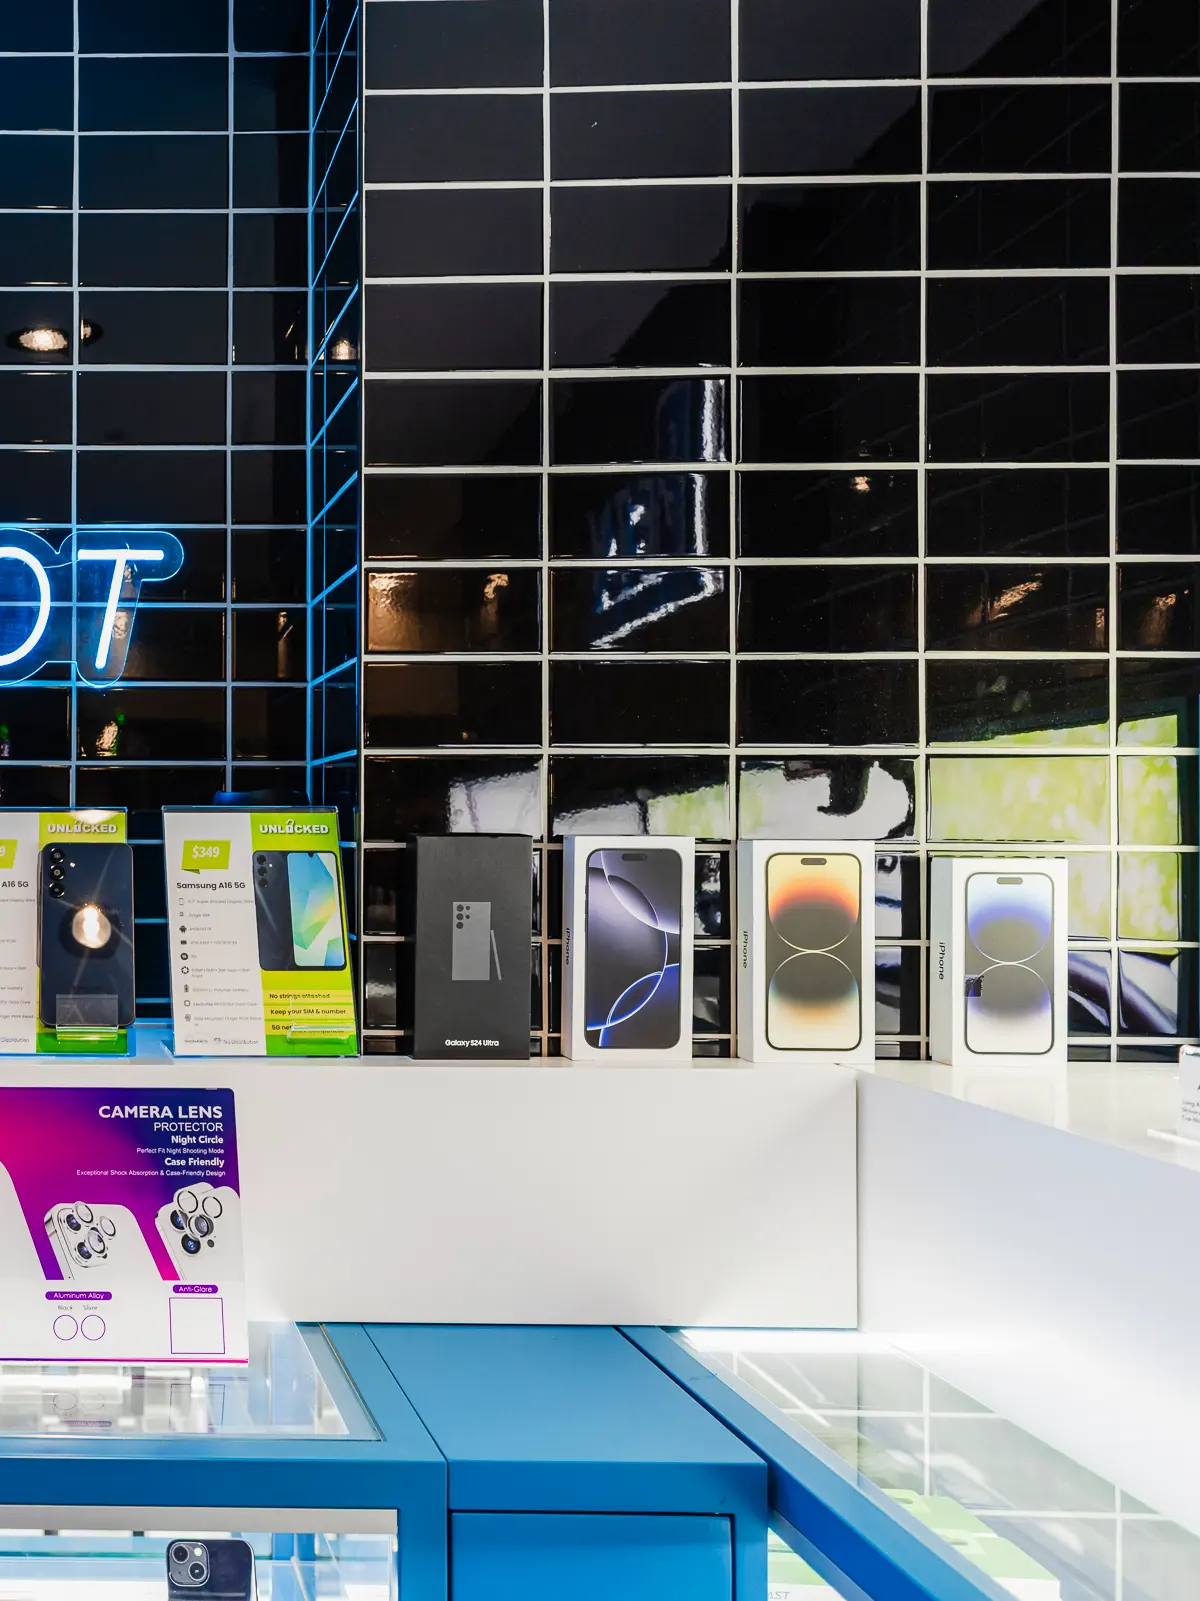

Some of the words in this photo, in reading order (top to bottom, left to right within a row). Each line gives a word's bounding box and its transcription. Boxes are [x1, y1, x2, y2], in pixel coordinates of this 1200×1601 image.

[47, 820, 117, 834] UNLOCKED
[259, 820, 329, 834] UNLOCKED
[192, 846, 220, 859] $349
[176, 882, 217, 890] Samsung
[938, 941, 946, 980] iPhone
[445, 1039, 470, 1048] Galaxy
[470, 1039, 482, 1047] S24
[483, 1039, 500, 1047] Ultra
[98, 1105, 174, 1119] CAMERA
[178, 1105, 223, 1119] LENS
[153, 1122, 223, 1132] PROTECTOR
[171, 1135, 197, 1145] Night
[198, 1135, 224, 1144] Circle
[166, 1147, 181, 1155] Night
[182, 1147, 207, 1155] Shooting
[164, 1157, 186, 1166] Case
[188, 1157, 225, 1168] Friendly
[76, 1169, 109, 1177] Exceptional
[128, 1169, 159, 1177] Absorption
[206, 1170, 226, 1178] Design
[178, 1285, 213, 1293] Anti-Glare
[88, 1292, 104, 1300] Alloy
